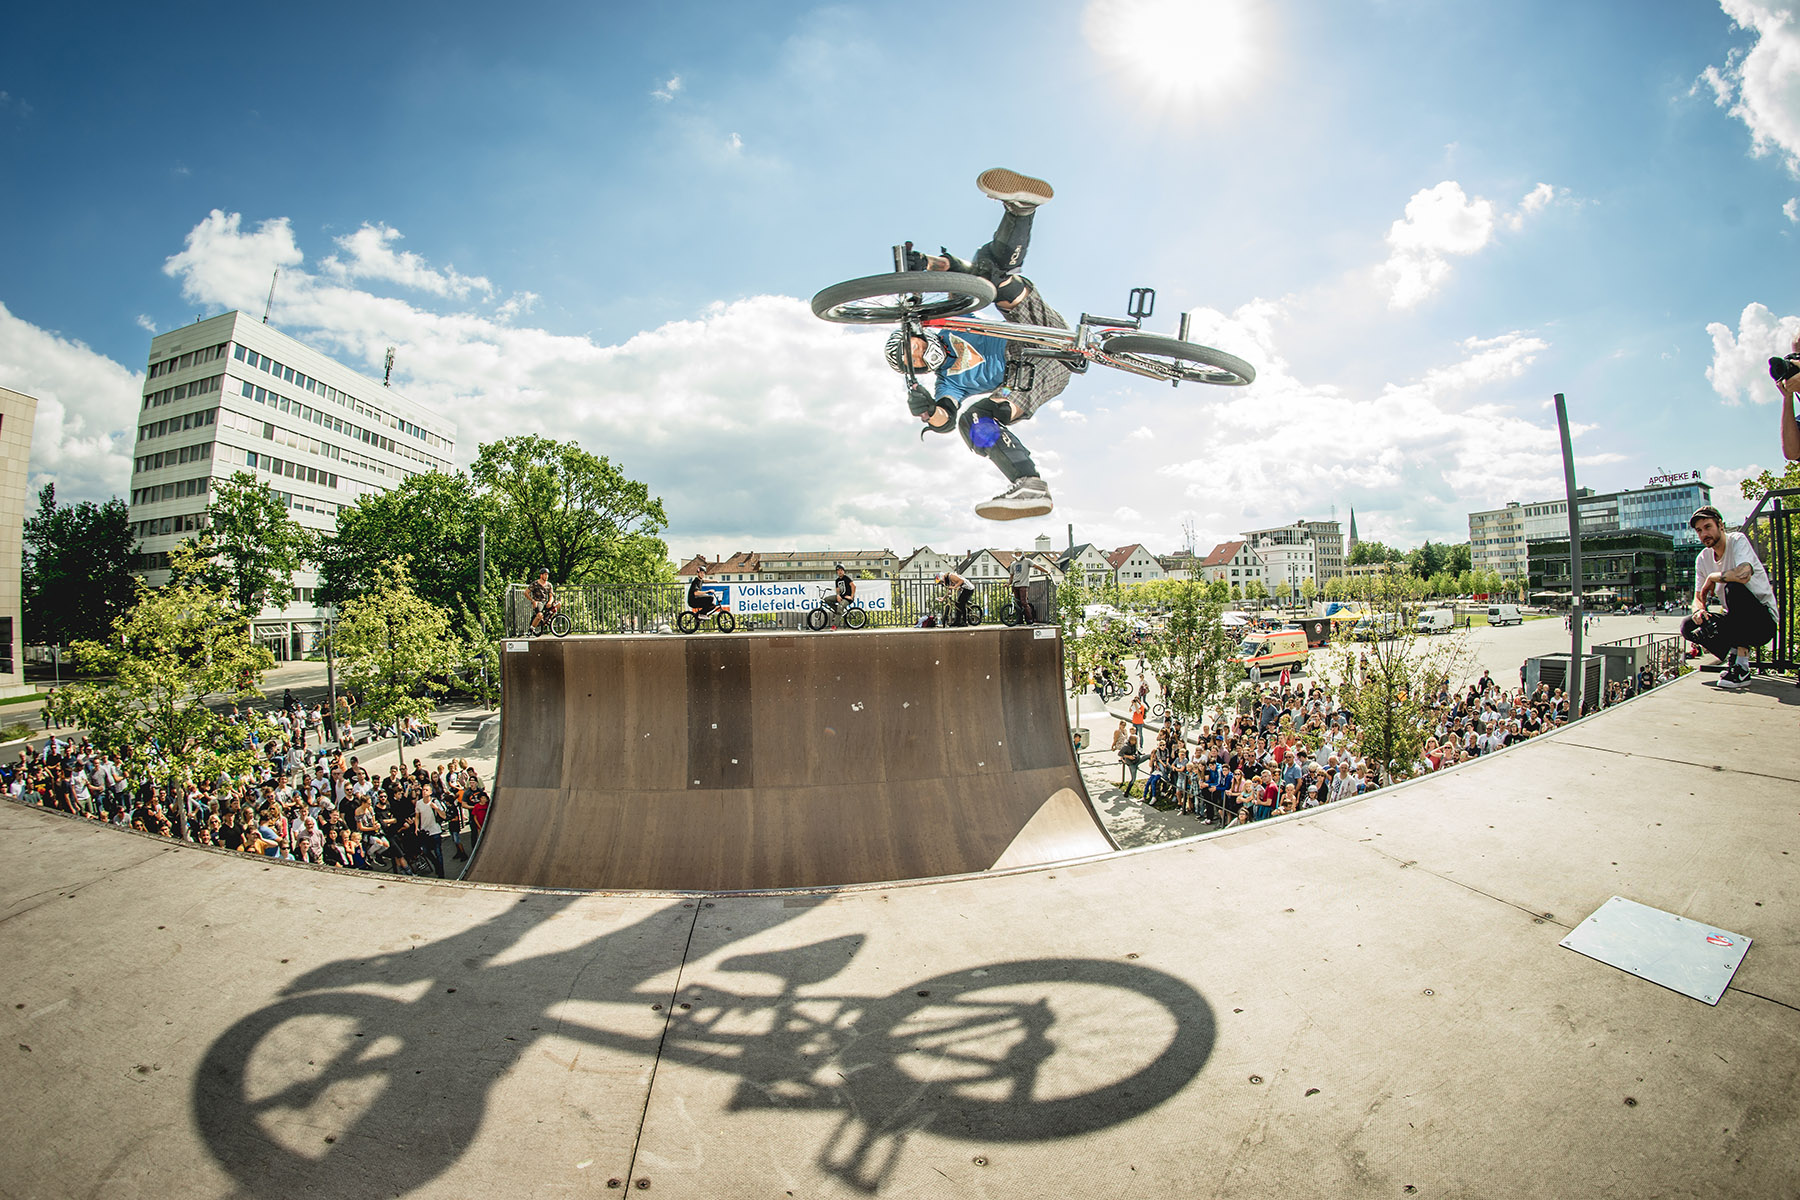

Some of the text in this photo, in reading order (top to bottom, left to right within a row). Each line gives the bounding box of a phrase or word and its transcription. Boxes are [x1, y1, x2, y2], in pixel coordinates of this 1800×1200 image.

[1648, 472, 1689, 484] APOTHEKE
[738, 584, 806, 596] Volksbank
[739, 597, 885, 611] Bielefeld-Güoh eG
